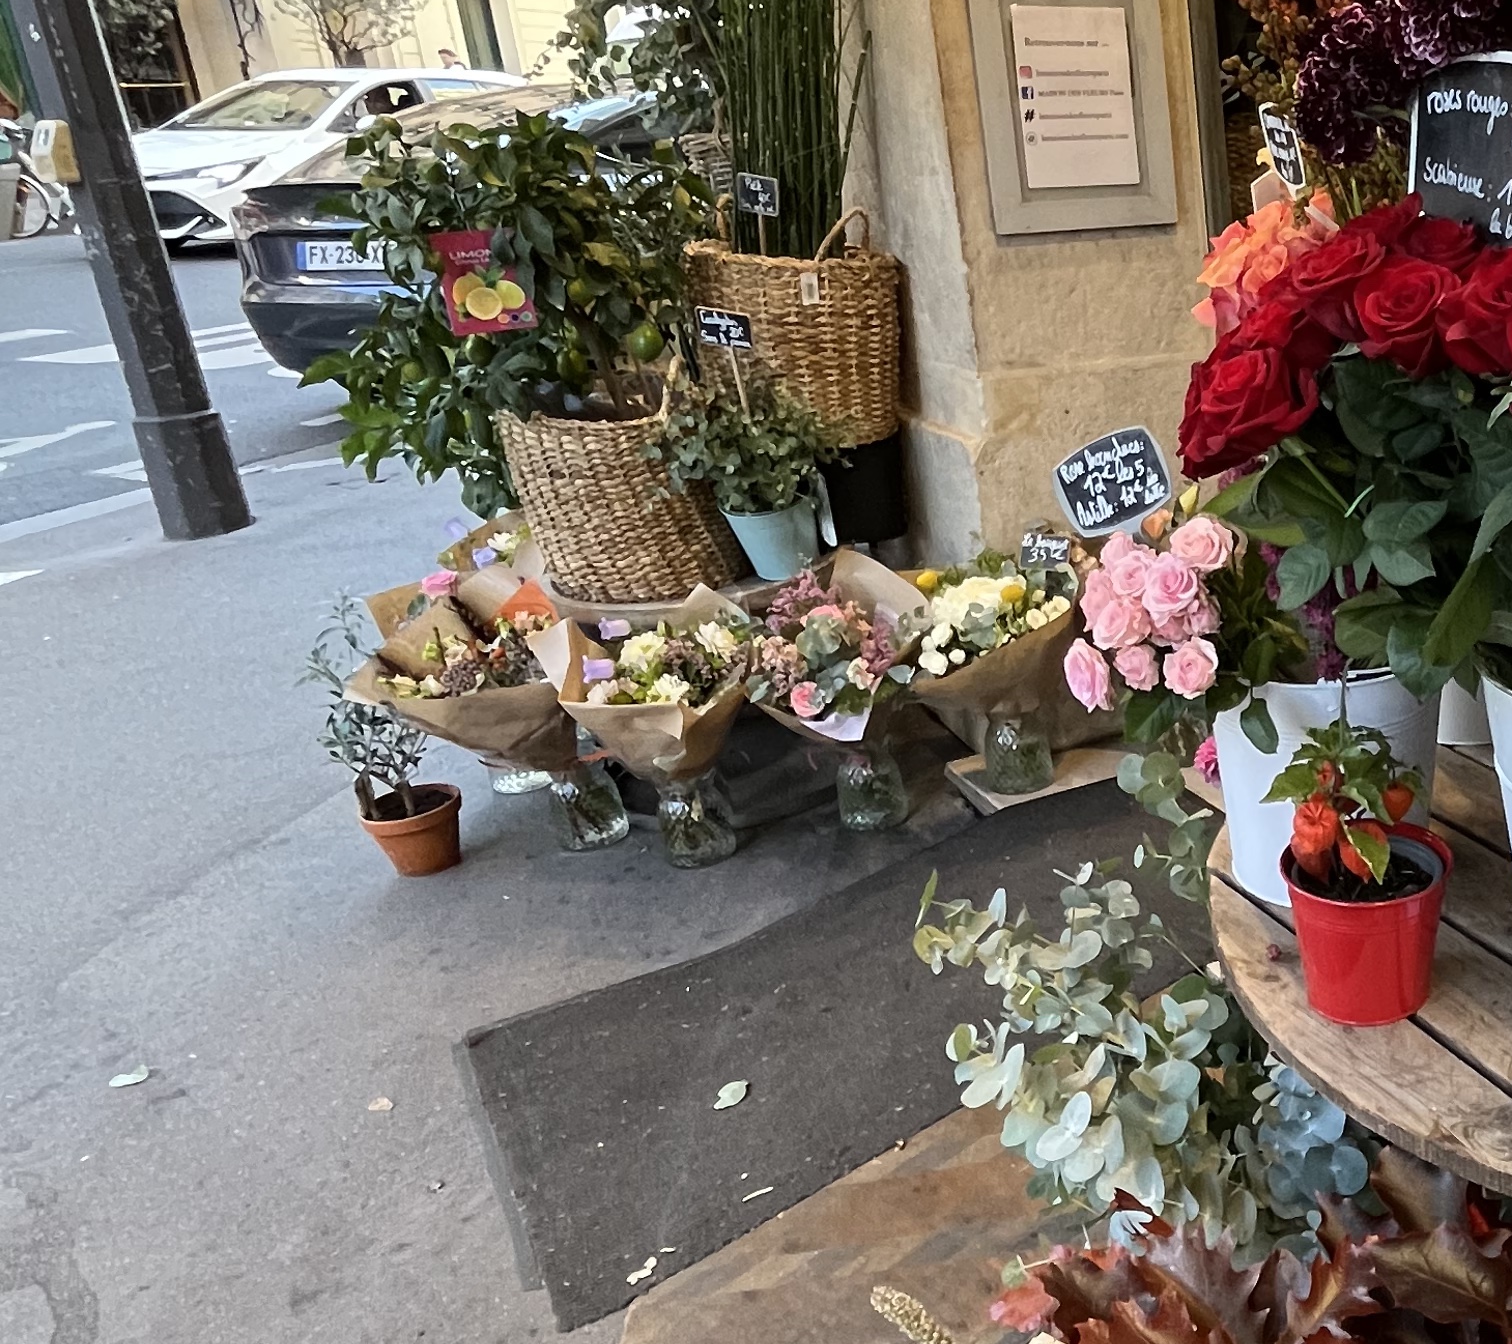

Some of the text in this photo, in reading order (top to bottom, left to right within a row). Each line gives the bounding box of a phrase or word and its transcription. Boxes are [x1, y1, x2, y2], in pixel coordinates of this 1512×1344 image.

[1489, 207, 1503, 234] la
[309, 245, 381, 265] FX-23-X
[1135, 458, 1145, 476] 5
